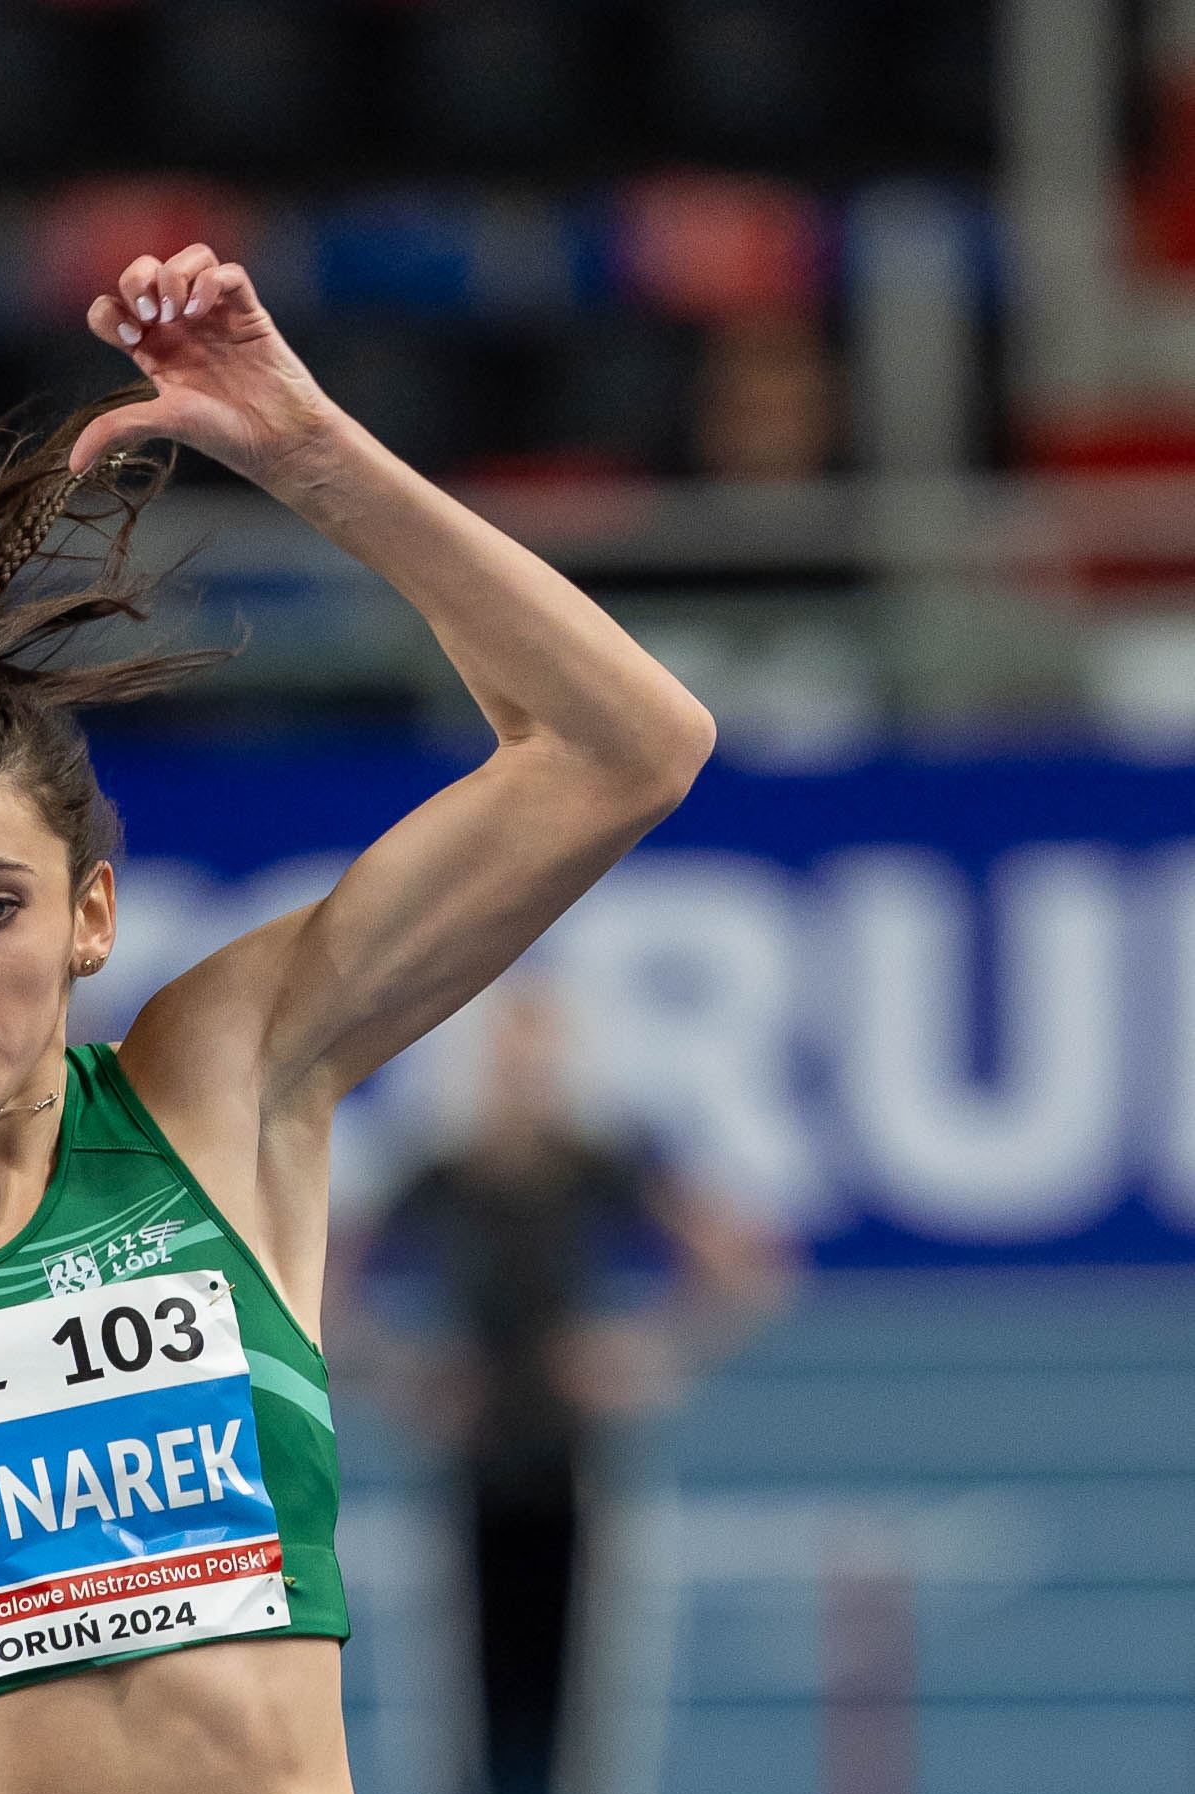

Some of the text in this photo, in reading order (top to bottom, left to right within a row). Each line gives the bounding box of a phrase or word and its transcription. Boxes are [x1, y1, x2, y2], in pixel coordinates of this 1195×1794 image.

[52, 1297, 204, 1386] 103
[69, 1562, 201, 1601] Mistrzostwa
[205, 1548, 268, 1576] Polski
[108, 1601, 196, 1640] 2024
